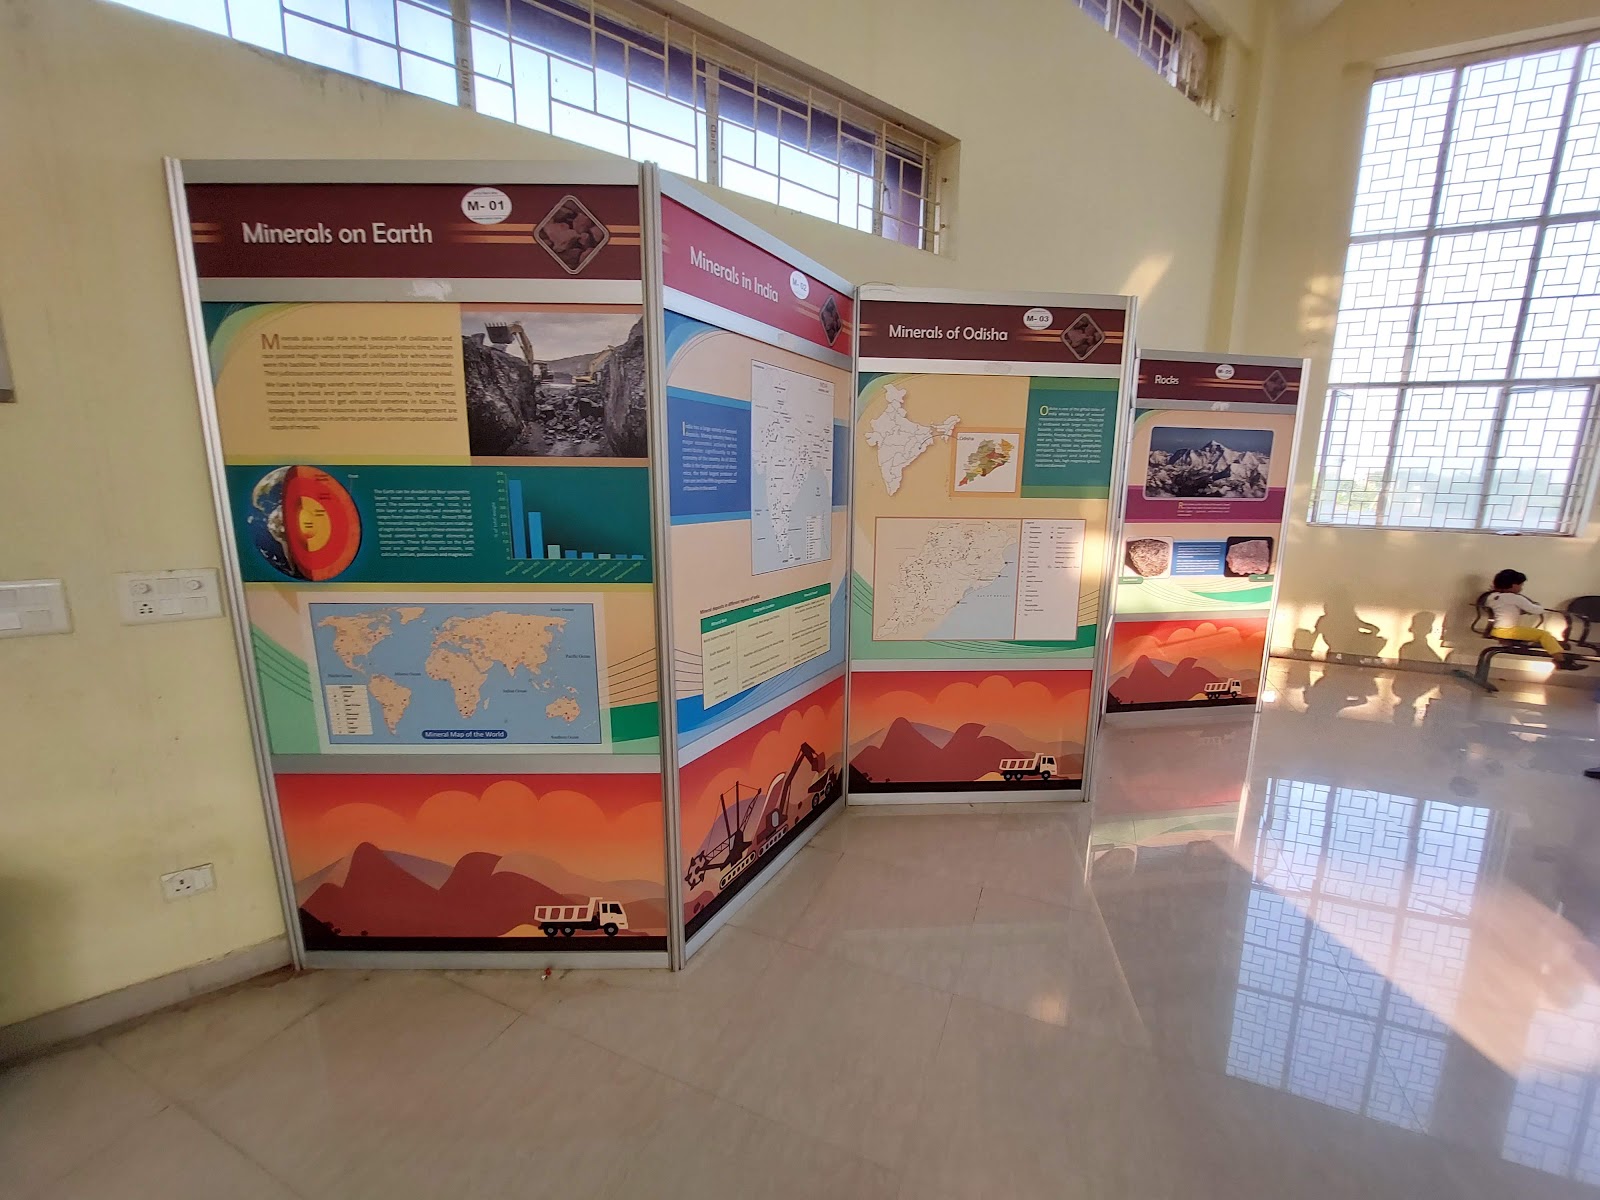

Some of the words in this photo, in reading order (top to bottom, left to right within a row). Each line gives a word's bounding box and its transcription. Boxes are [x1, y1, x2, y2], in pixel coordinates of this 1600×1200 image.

[489, 200, 504, 211] 01
[241, 222, 333, 244] Minerals
[338, 227, 366, 244] on
[371, 222, 433, 244] Earth
[690, 245, 740, 285] Minerals
[741, 272, 752, 291] in
[754, 276, 779, 302] India
[1039, 315, 1050, 323] 03
[889, 324, 943, 339] Minerals
[946, 326, 960, 340] of
[963, 326, 1008, 341] Odisha
[1154, 374, 1180, 385] Rocks
